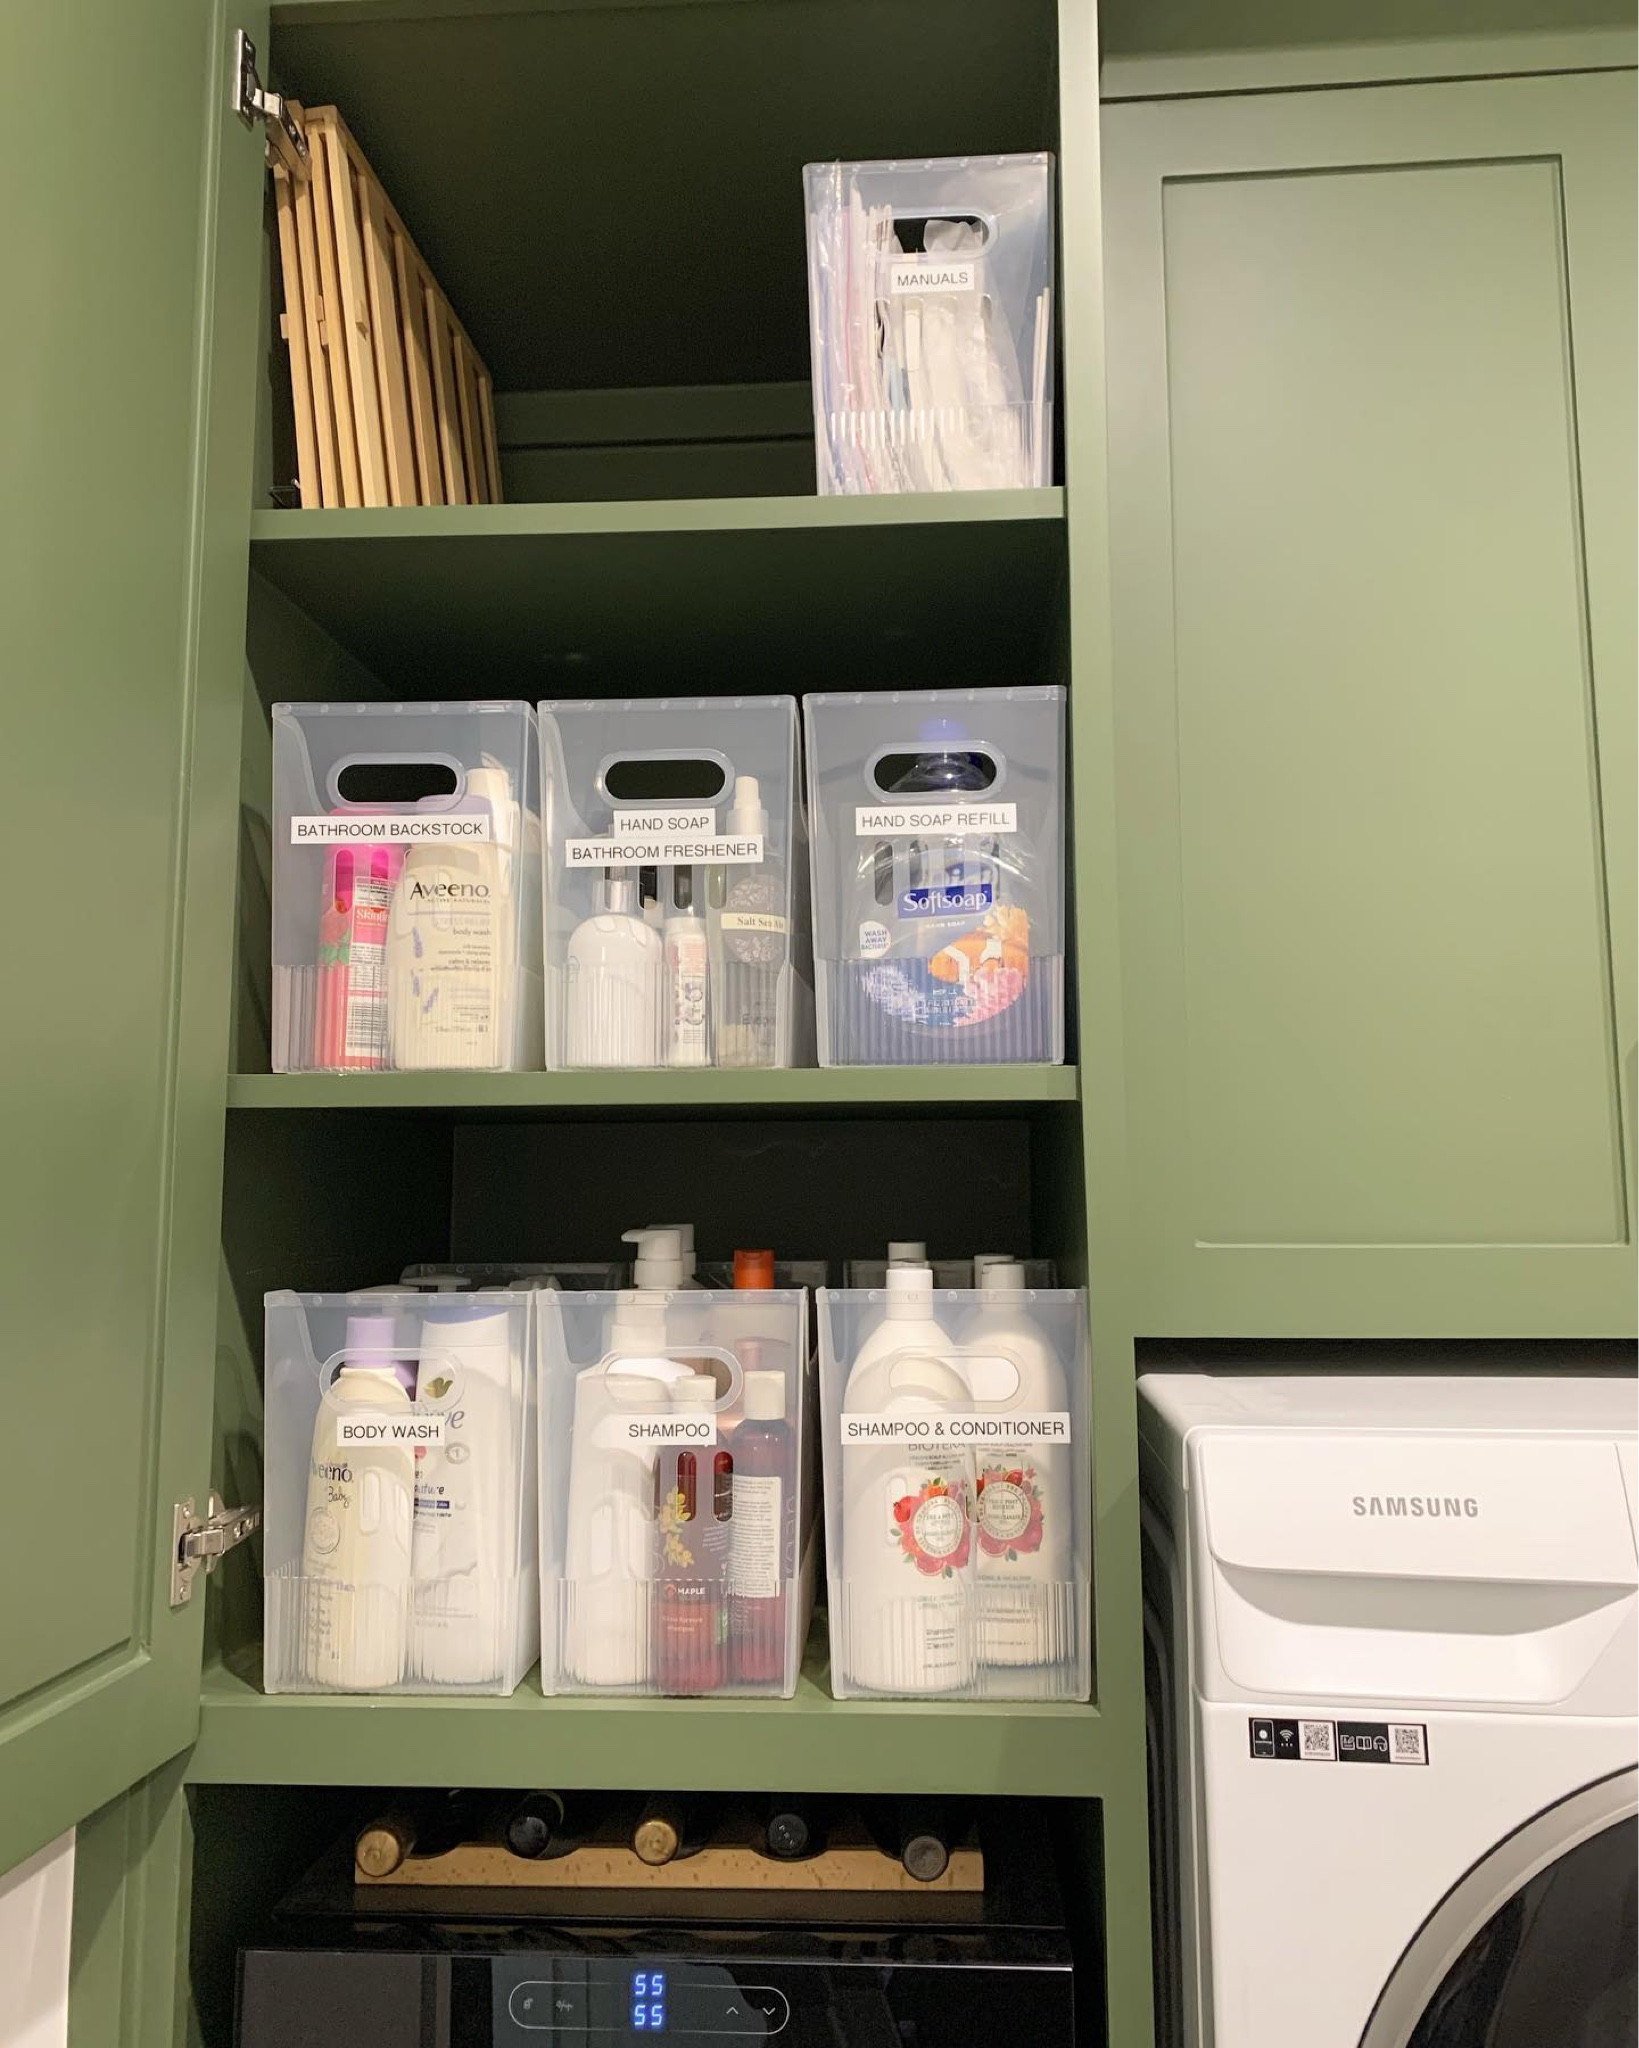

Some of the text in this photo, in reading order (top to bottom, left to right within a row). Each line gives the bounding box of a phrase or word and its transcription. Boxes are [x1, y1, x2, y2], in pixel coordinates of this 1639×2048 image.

[897, 272, 969, 287] MANUALS
[620, 816, 709, 831] HAND SOAP
[862, 812, 1010, 828] HAND SOAP REFILL
[297, 822, 482, 837] BATHROOM BACKSTOCK
[572, 843, 758, 860] BATHROOM FRESHENER
[409, 881, 489, 900] Aveeno
[903, 889, 987, 914] Softsoap
[737, 917, 756, 927] Salt
[865, 930, 888, 938] WASH
[343, 1425, 440, 1440] BODY WASH
[628, 1423, 711, 1438] SHAMPOO
[848, 1421, 1065, 1437] SHAMPOO & CONDITIONER
[1353, 1496, 1479, 1519] SAMSUNG
[677, 1586, 706, 1595] MAPLE
[635, 1974, 663, 1996] 55
[634, 2004, 663, 2026] 55
